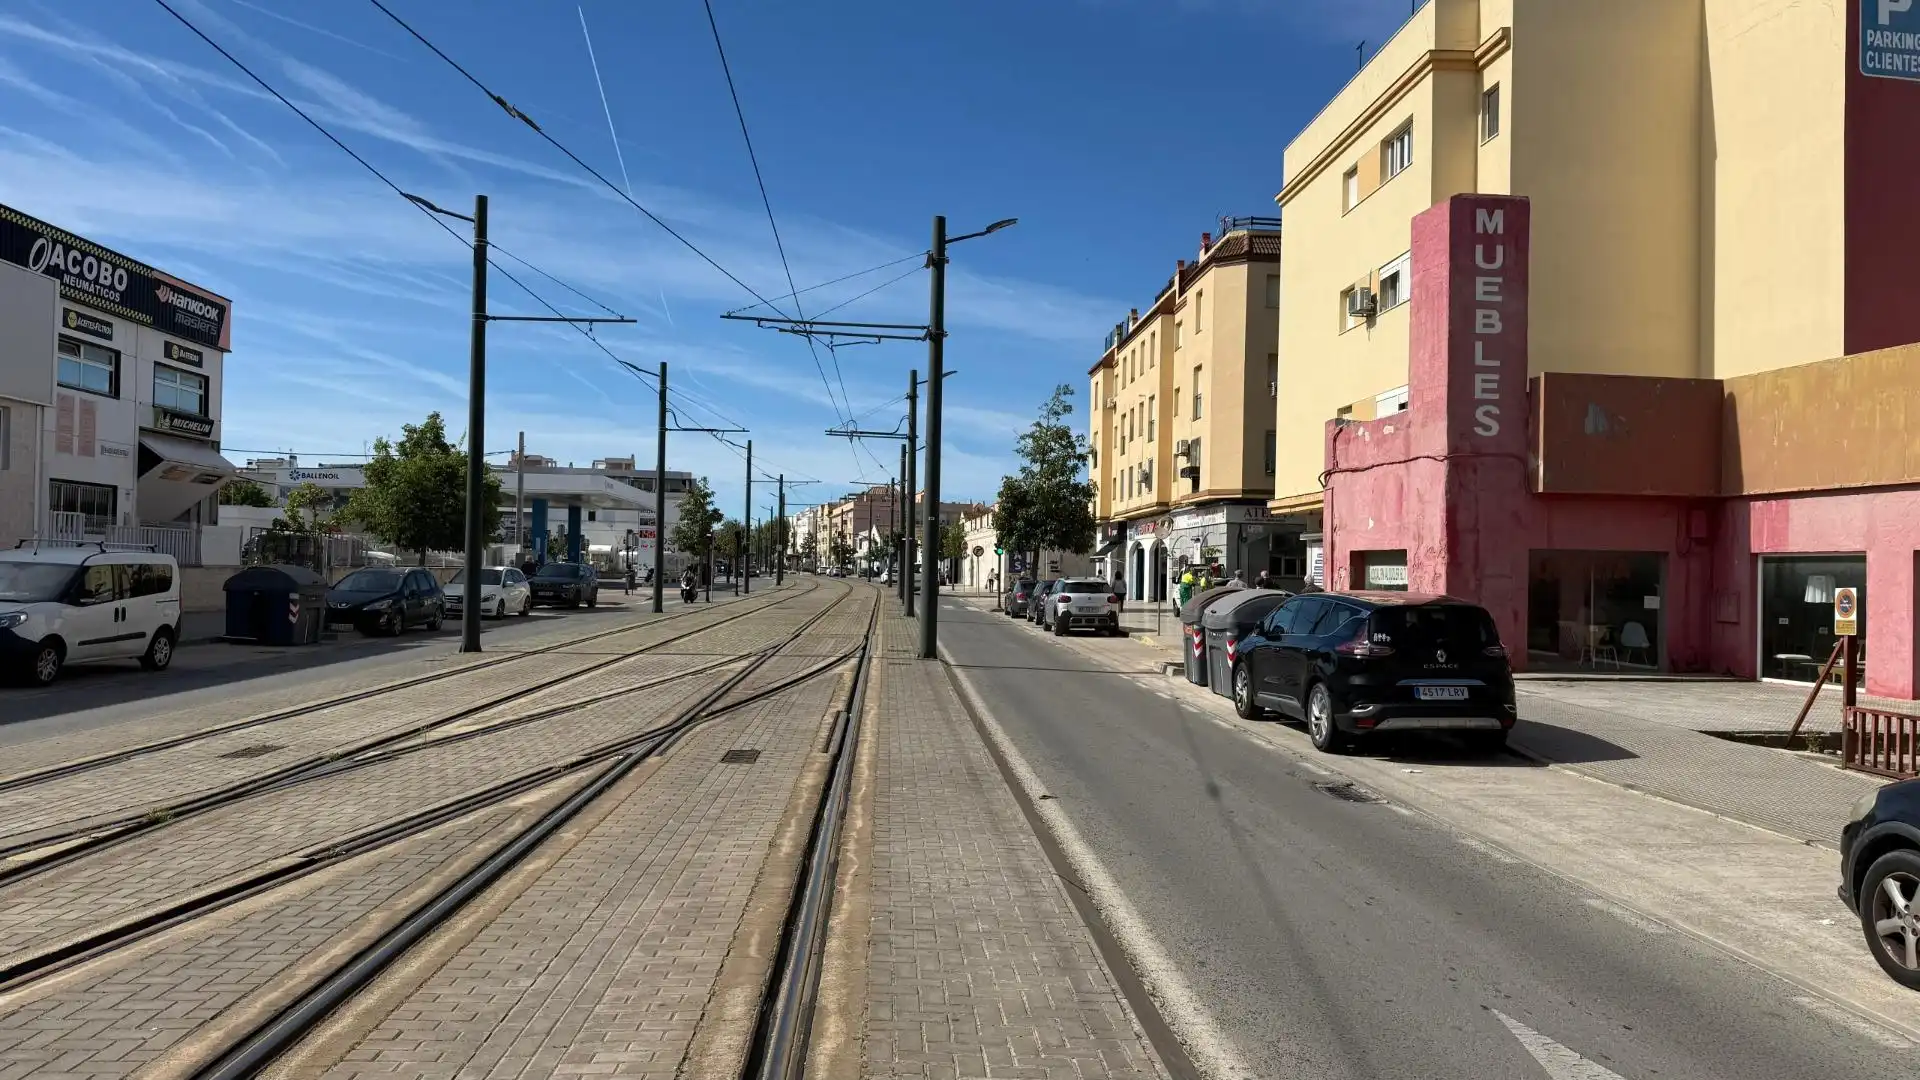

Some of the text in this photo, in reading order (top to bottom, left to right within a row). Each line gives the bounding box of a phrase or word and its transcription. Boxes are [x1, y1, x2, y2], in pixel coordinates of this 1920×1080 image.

[1877, 0, 1912, 25] P
[1866, 29, 1920, 51] PARKING
[63, 273, 121, 302] NEUMÁTICOS
[175, 312, 218, 336] masters
[1474, 208, 1504, 437] MUEBLES
[172, 418, 211, 433] MICHELIN
[301, 472, 340, 480] BALLENOIL
[1422, 687, 1465, 697] 4517 LRV
